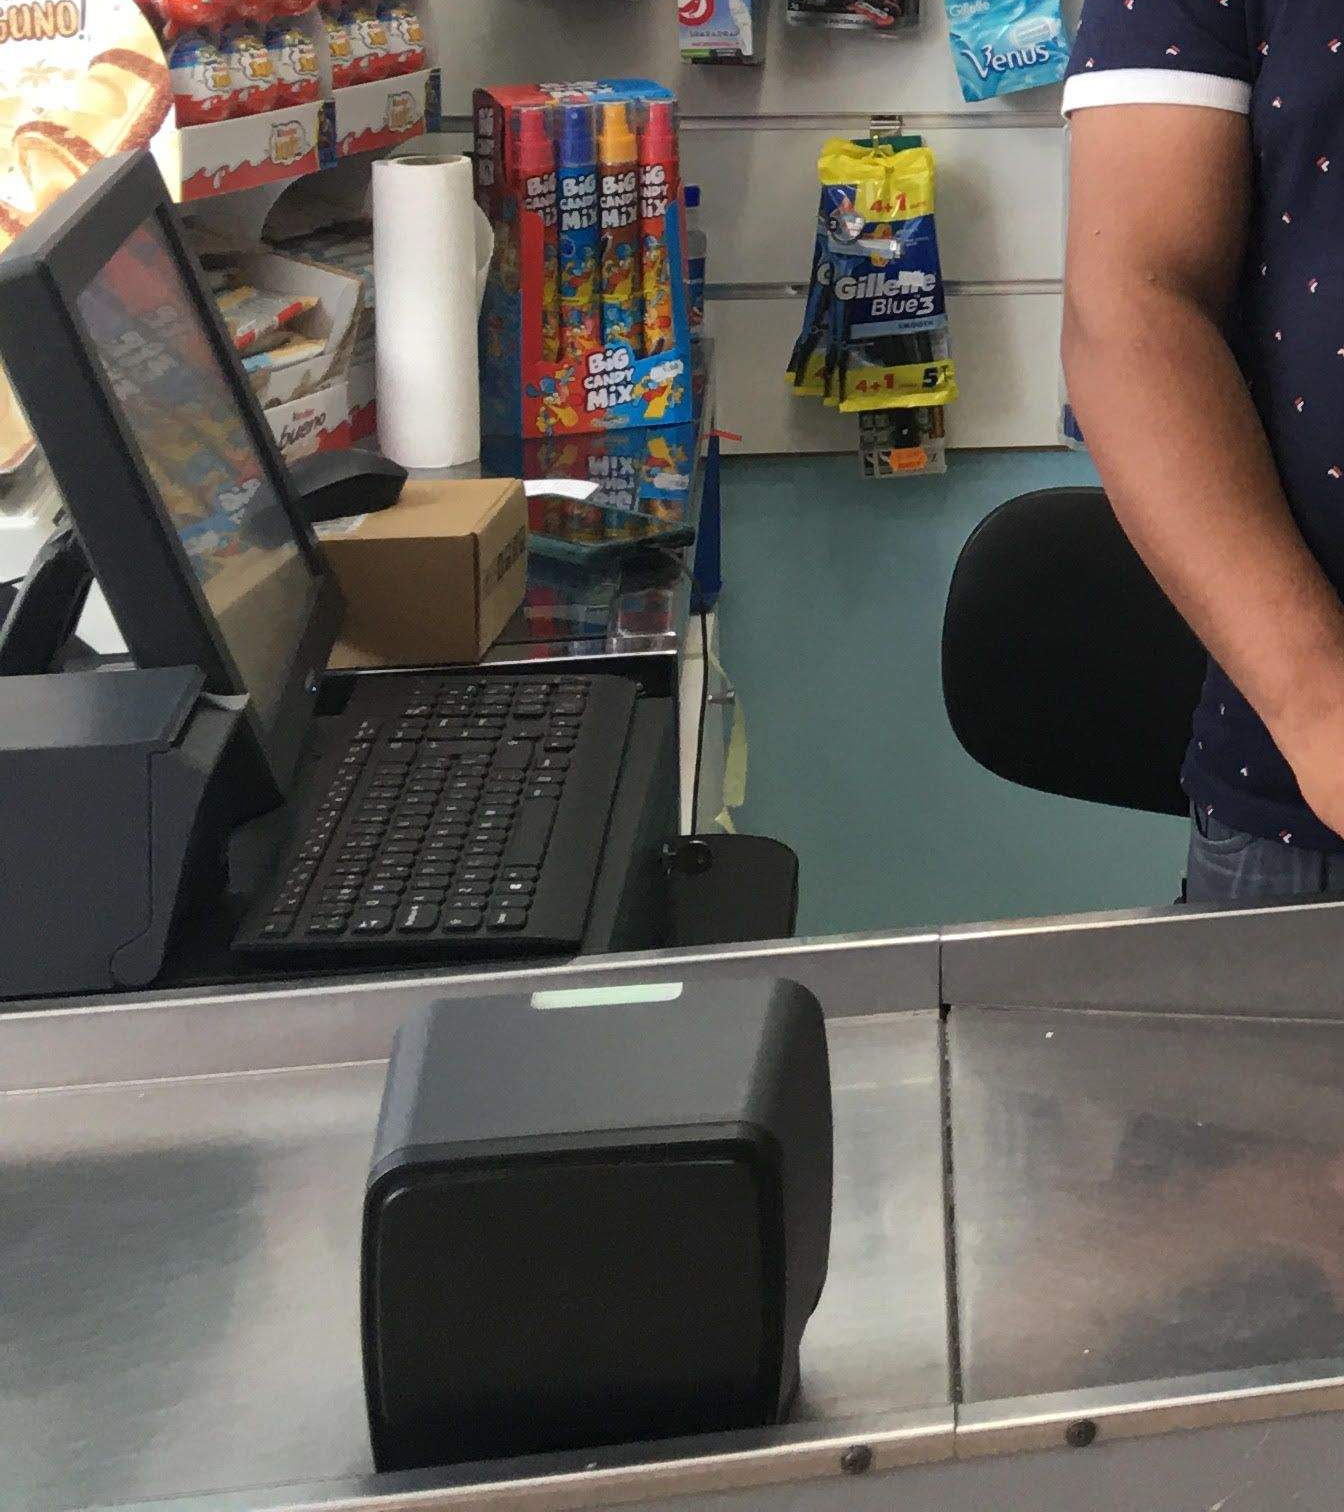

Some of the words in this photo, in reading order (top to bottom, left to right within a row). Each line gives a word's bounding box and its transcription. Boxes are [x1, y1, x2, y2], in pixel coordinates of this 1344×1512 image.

[962, 44, 1051, 79] Venus
[870, 193, 908, 218] 4+1
[835, 271, 936, 301] Gillette
[583, 368, 634, 390] CANDY
[856, 374, 896, 393] 4+1
[280, 412, 327, 448] bueno
